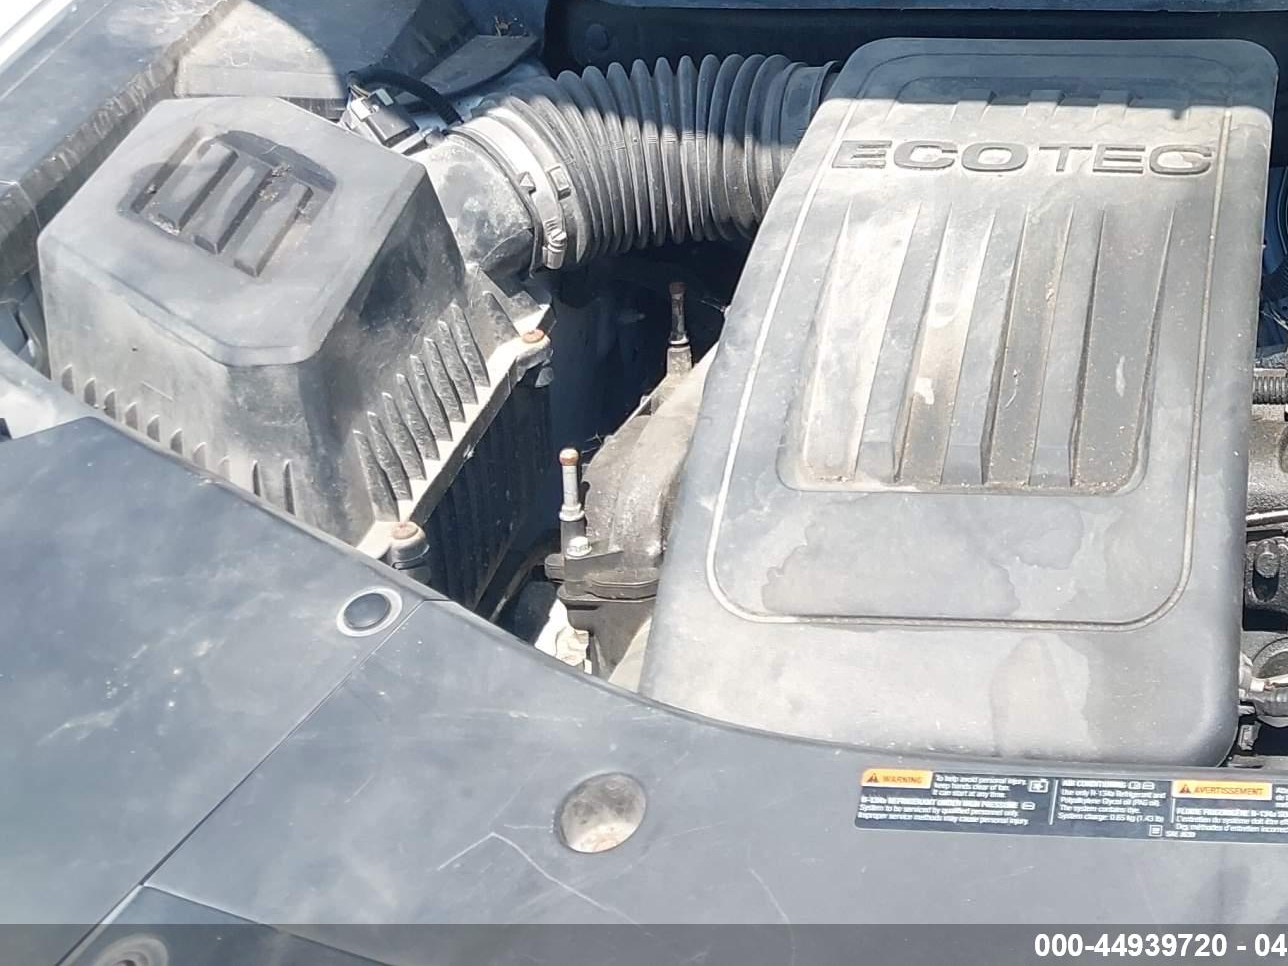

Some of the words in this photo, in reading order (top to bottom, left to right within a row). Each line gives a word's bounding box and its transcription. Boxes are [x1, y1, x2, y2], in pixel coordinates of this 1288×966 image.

[831, 139, 1217, 176] ECOTEC
[1194, 786, 1264, 795] AVERTISSEMENT
[859, 804, 885, 812] System
[1057, 812, 1083, 820] System
